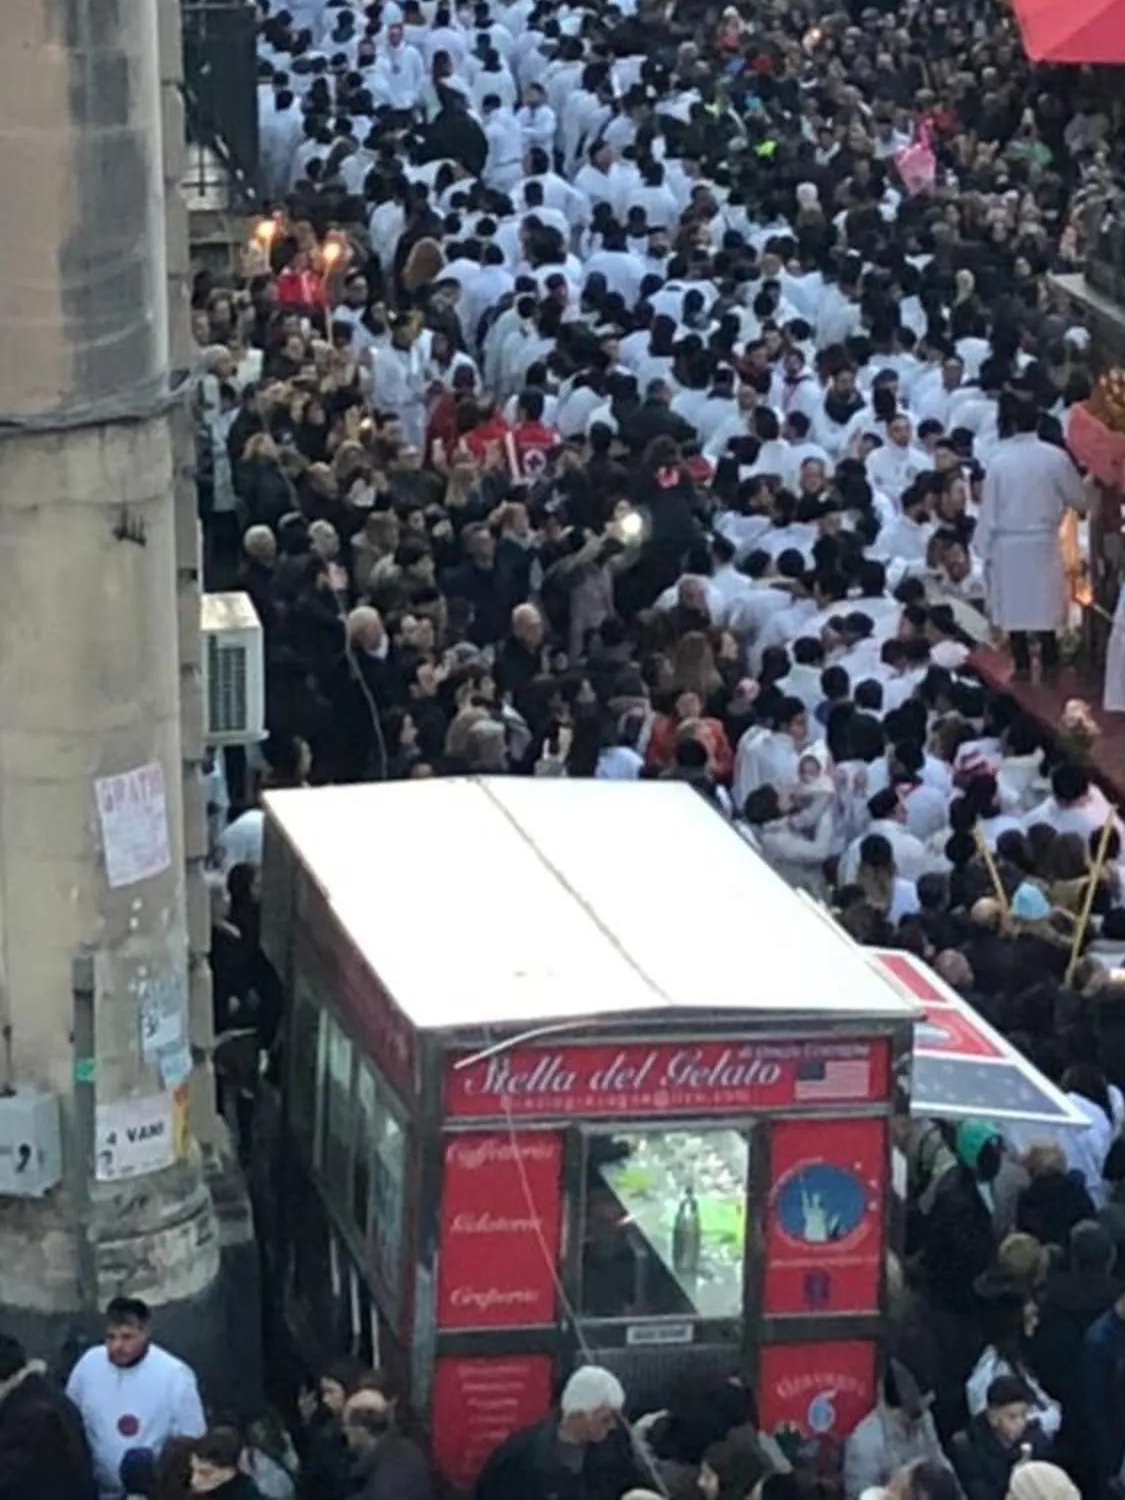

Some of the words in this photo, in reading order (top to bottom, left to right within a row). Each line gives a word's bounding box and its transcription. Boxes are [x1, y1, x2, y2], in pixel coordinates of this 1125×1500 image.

[588, 1051, 658, 1092] del
[659, 1048, 781, 1089] Gelato
[126, 1121, 165, 1143] VANI
